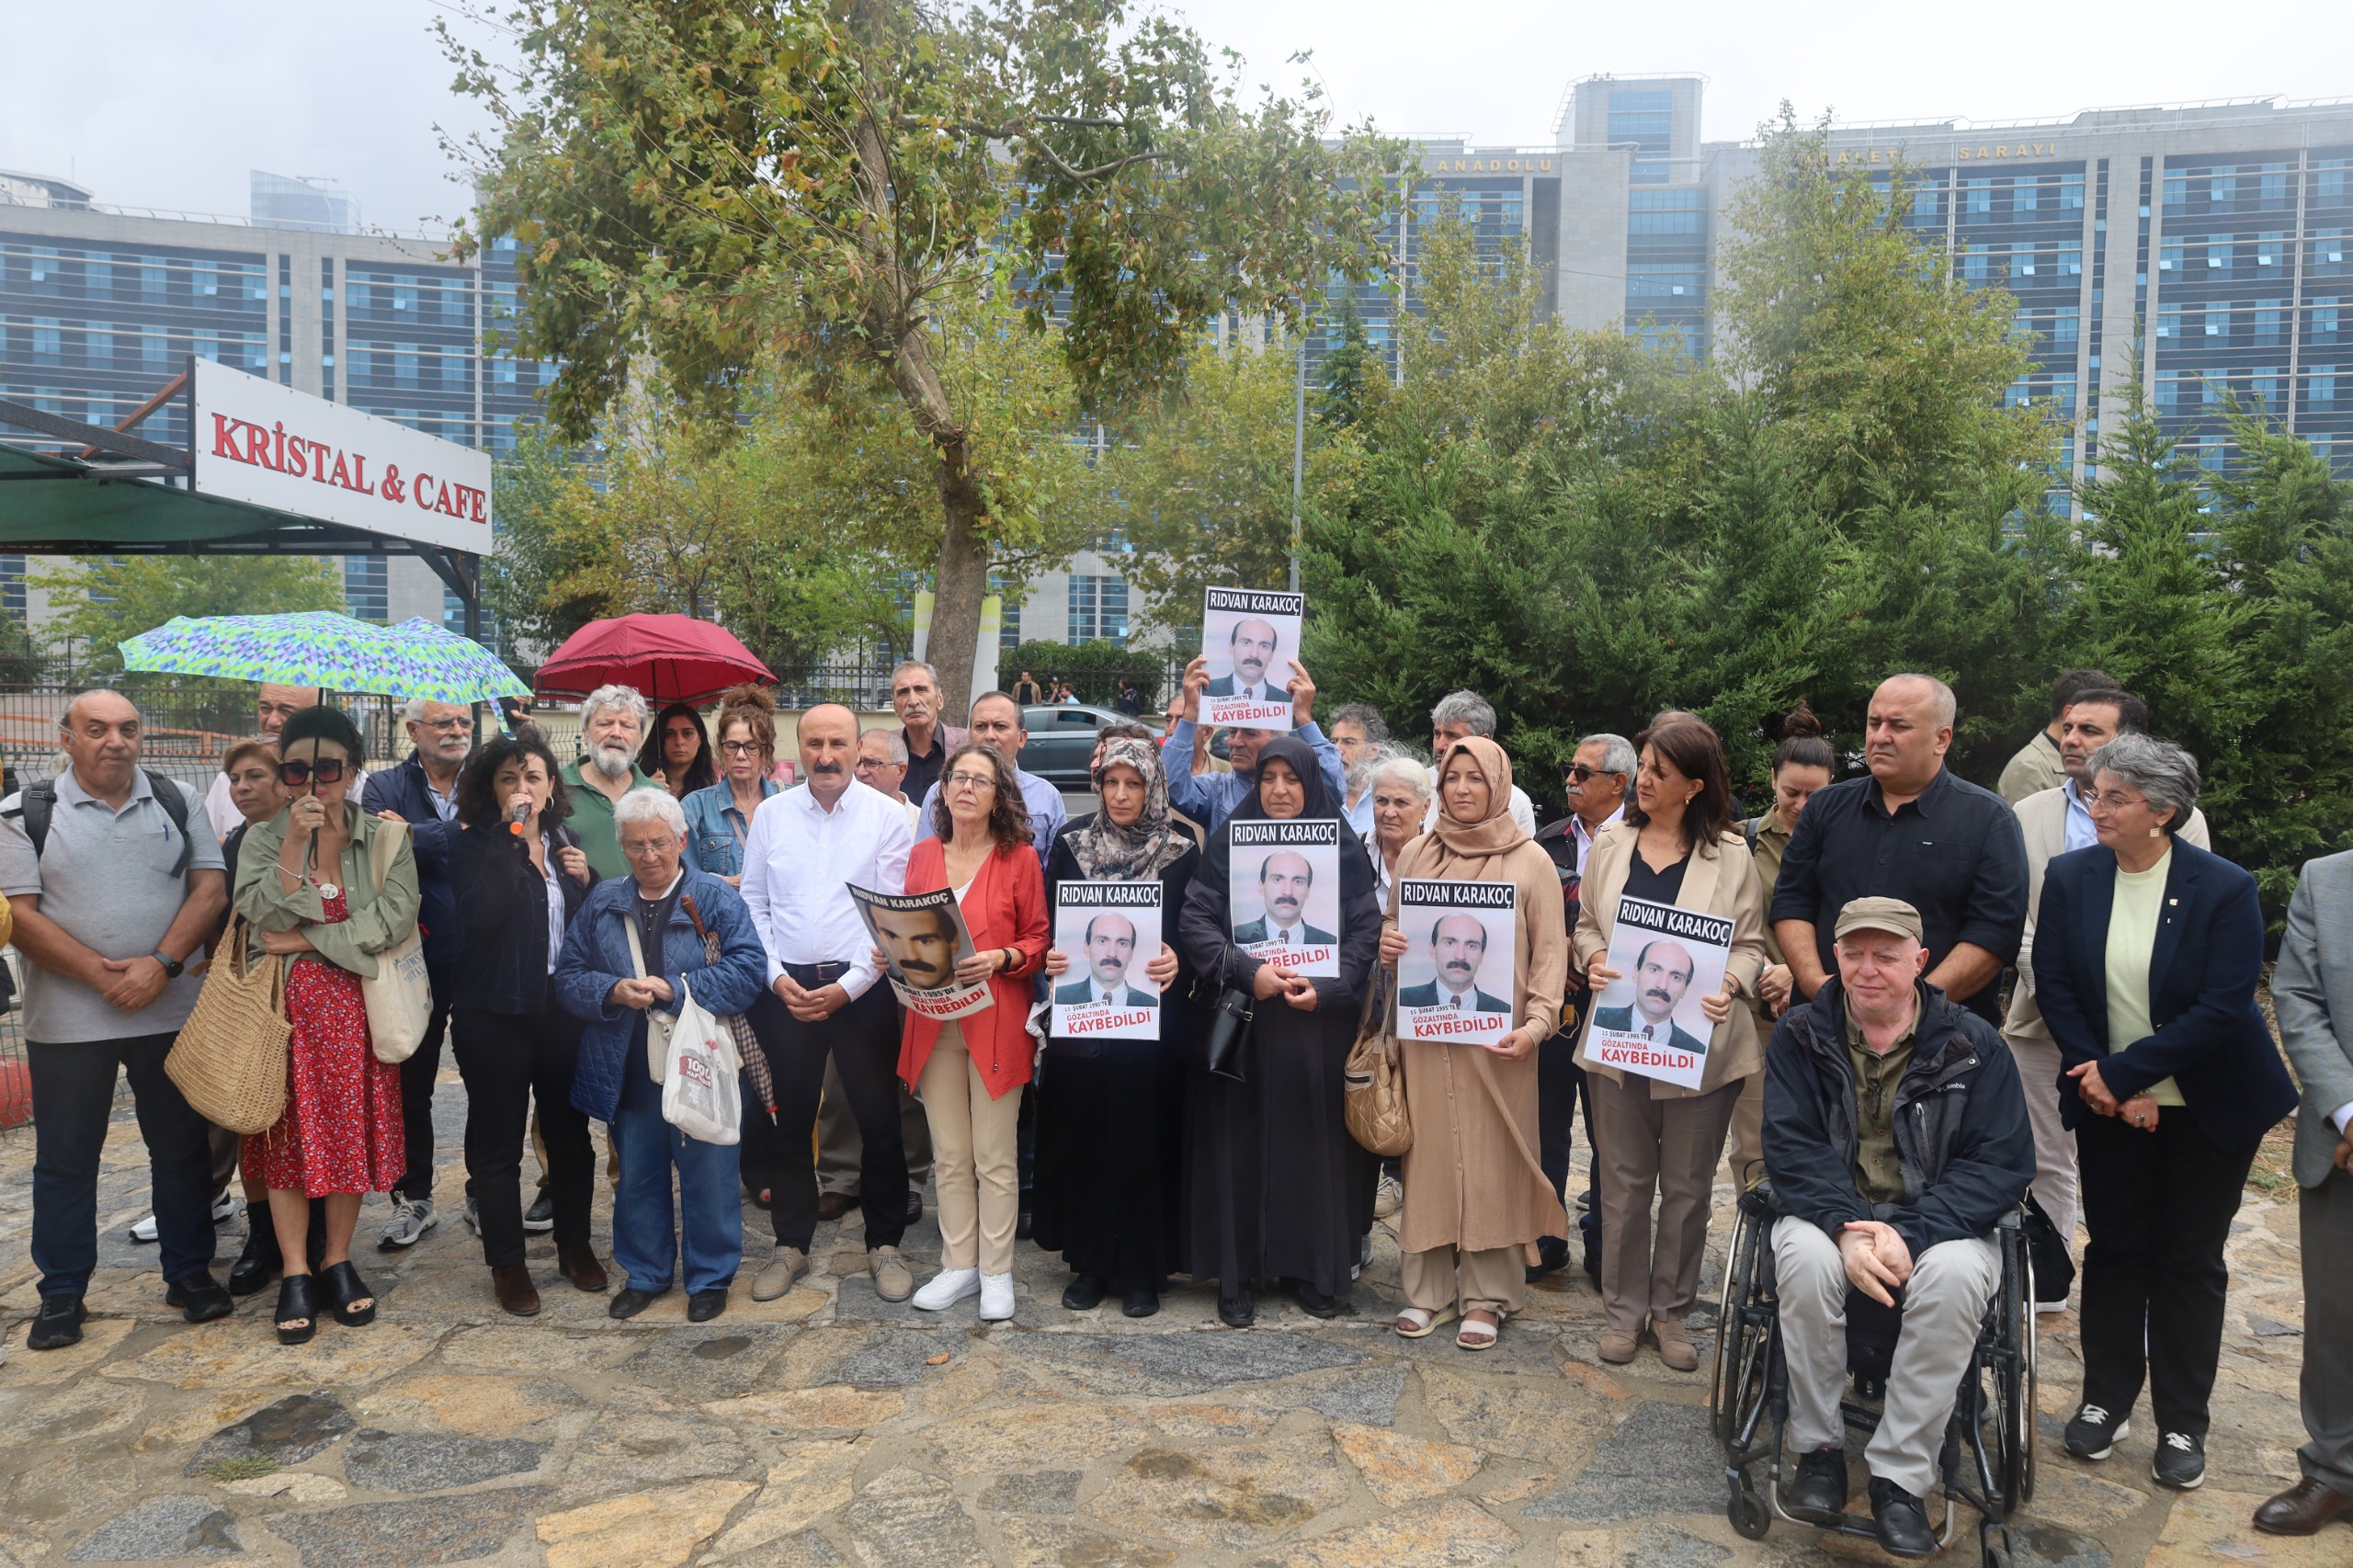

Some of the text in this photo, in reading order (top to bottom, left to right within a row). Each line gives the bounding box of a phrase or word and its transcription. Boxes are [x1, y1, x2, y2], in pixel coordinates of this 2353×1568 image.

[1437, 142, 2056, 173] ANADOLU ALET SARAYI
[210, 412, 487, 524] KRİSTAL & CAFE
[1210, 592, 1301, 616] RIDVAN KARAKOÇ
[1212, 703, 1286, 722] KAYBEDİLDİ
[1234, 824, 1336, 845] RIDVAN KARAKOÇ
[851, 886, 949, 908] RIDVAN KARAKOÇ
[1061, 886, 1159, 907] RIDVAN KARAKOÇ
[1404, 884, 1513, 909] RIDVAN KARAKOÇ
[1620, 902, 1730, 946] RIDVAN KARAKOÇ
[1265, 945, 1330, 968] YBEDİLDİ
[913, 988, 986, 1015] KAYBEDİLDİ
[1066, 1009, 1110, 1021] GÖZALTINDA
[1068, 1007, 1152, 1034] KAYBEDİLDİ
[1413, 1013, 1459, 1024] GÖZALTINDA
[1415, 1014, 1504, 1037] KAYBEDİLDİ
[1601, 1039, 1648, 1051] GÖZALTINDA
[1601, 1048, 1694, 1069] KAYBEDİLDİ
